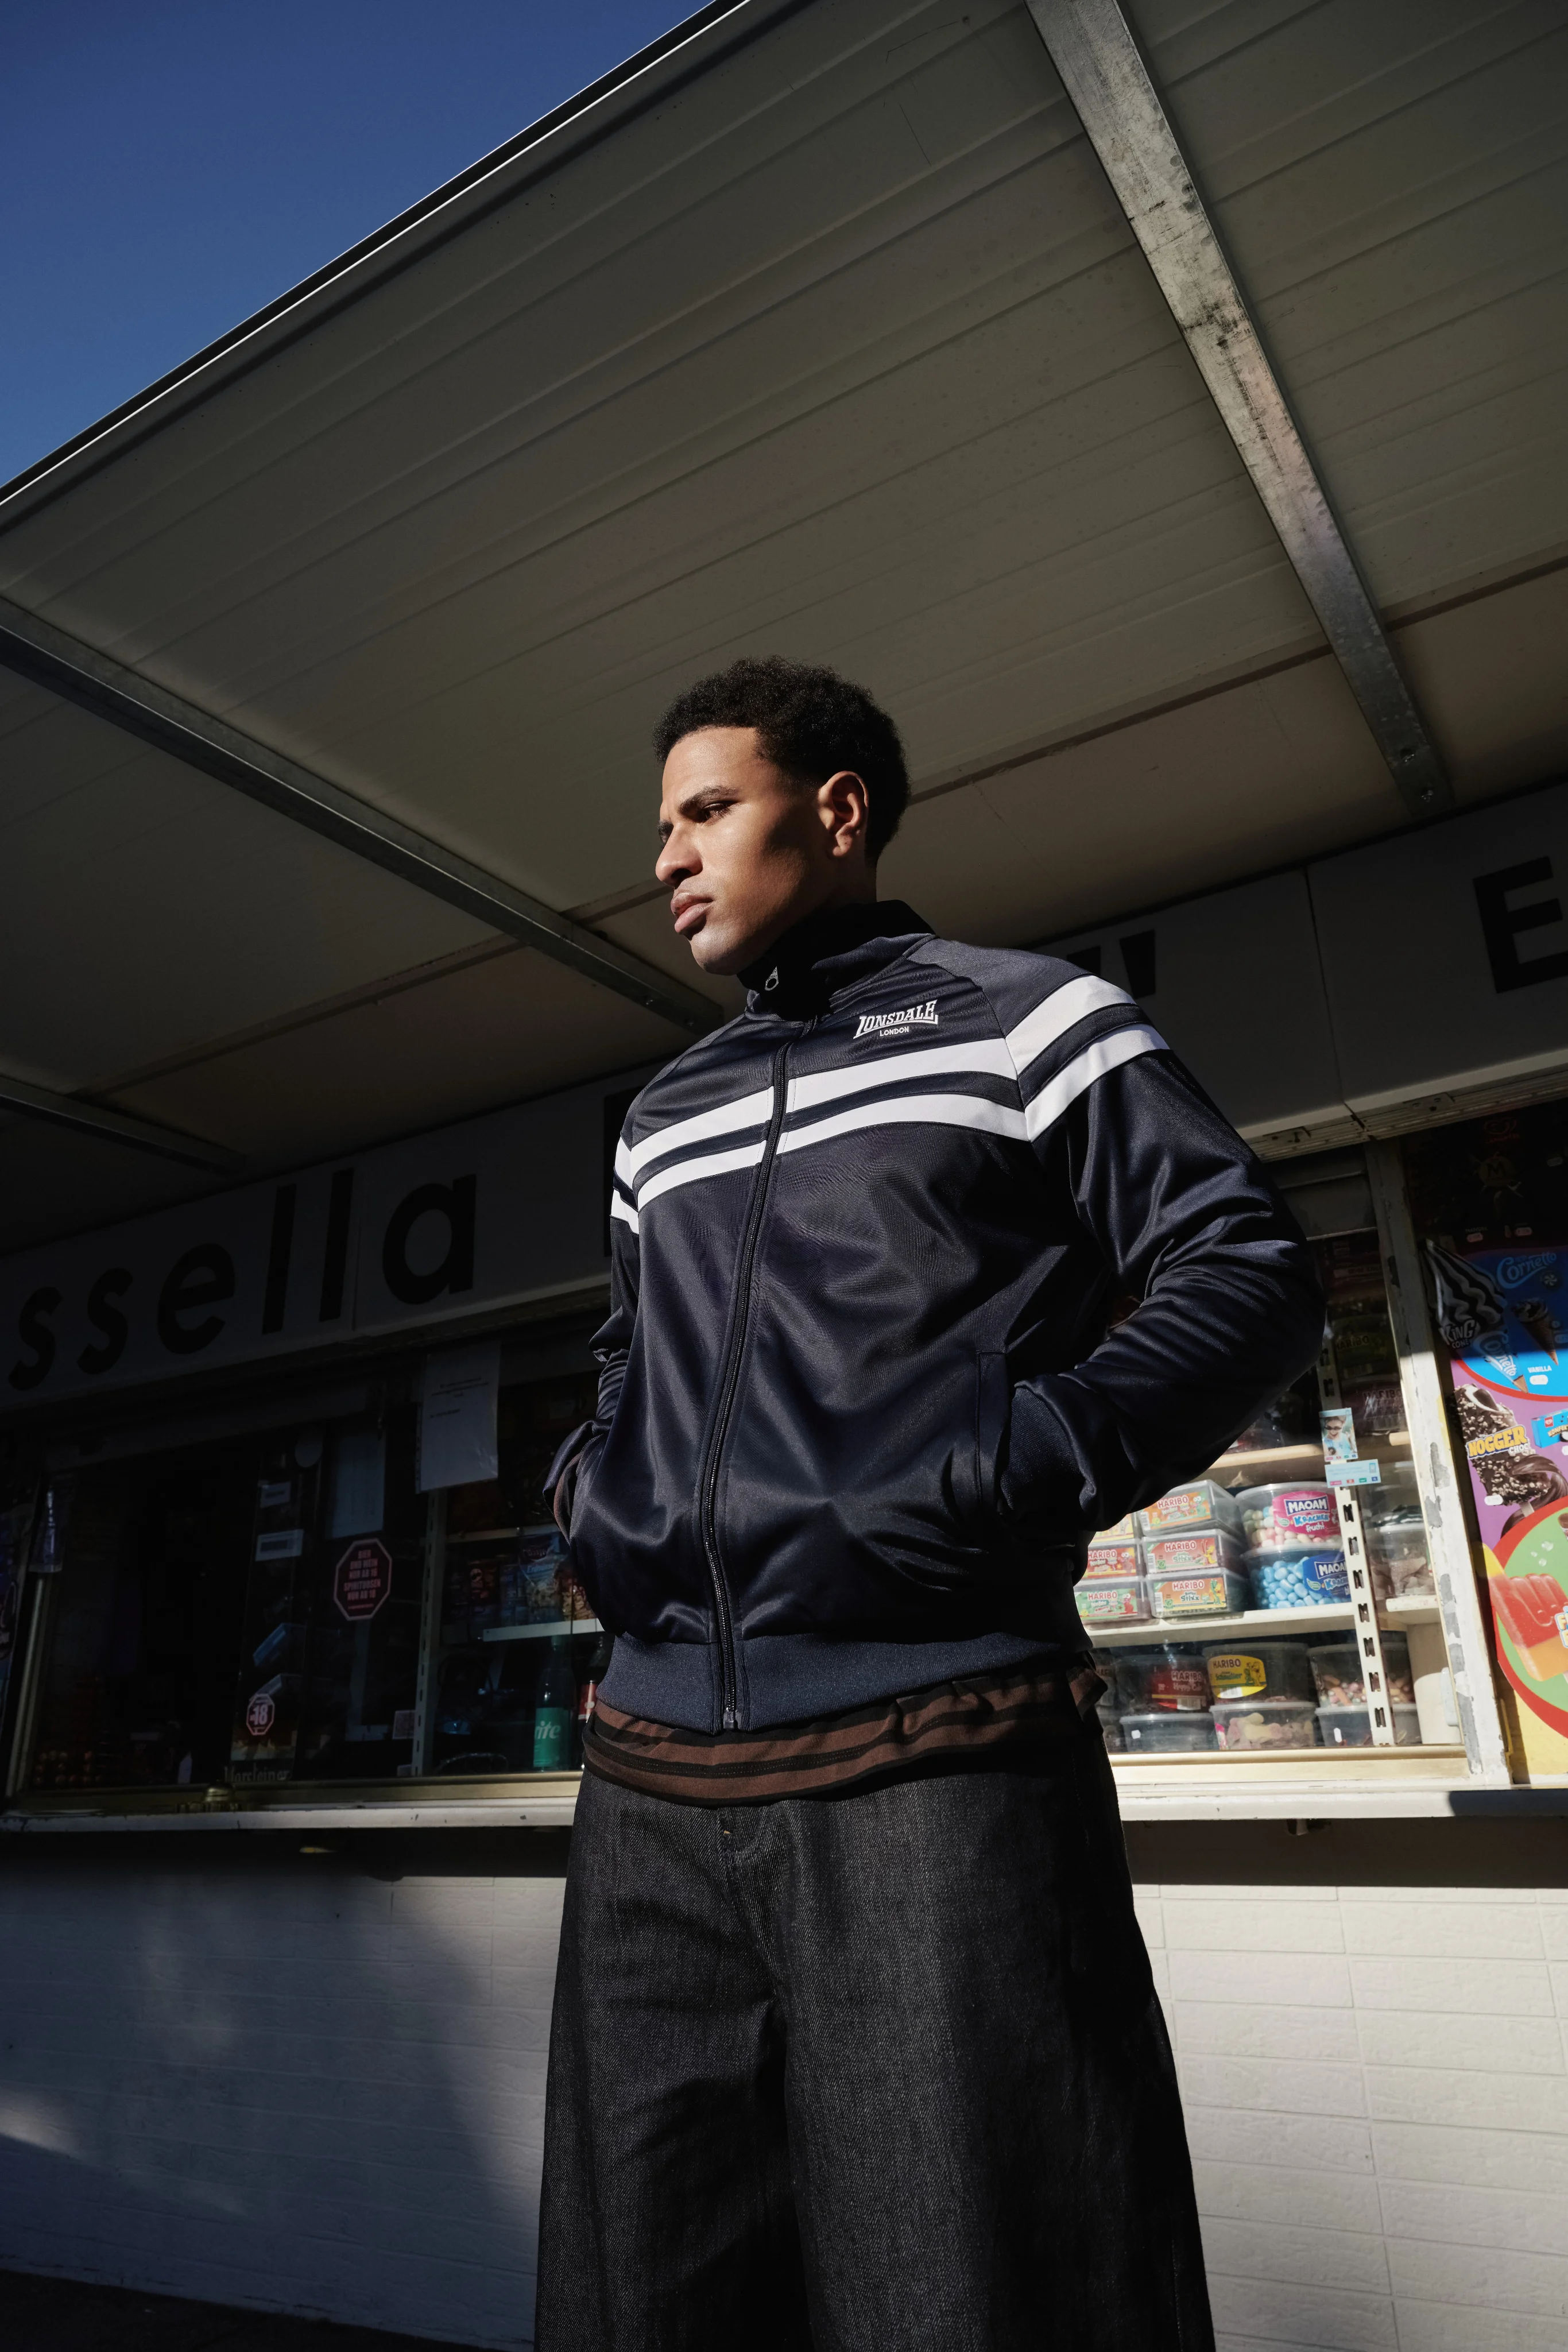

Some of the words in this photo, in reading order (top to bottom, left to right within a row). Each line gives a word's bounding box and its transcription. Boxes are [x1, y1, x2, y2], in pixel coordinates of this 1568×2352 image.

[853, 999, 938, 1039] LONSDALE
[880, 1026, 909, 1036] LONDON
[1496, 1251, 1557, 1289] Cornetto
[1451, 1338, 1470, 1349] CONE
[1527, 1365, 1552, 1373] VANILLA
[1468, 1426, 1527, 1458] NOGGER
[1508, 1444, 1529, 1454] CHOC
[1157, 1495, 1188, 1510] HARIBO
[1288, 1499, 1327, 1513] MAOAM
[1164, 1541, 1197, 1552] HARIBO
[1088, 1549, 1117, 1560] HARIBO
[1172, 1580, 1205, 1591] HARIBO
[1088, 1591, 1117, 1601] HARIBO
[1213, 1658, 1241, 1669] HARIBO
[1171, 1670, 1202, 1681] HARIBO
[253, 1704, 268, 1725] 18
